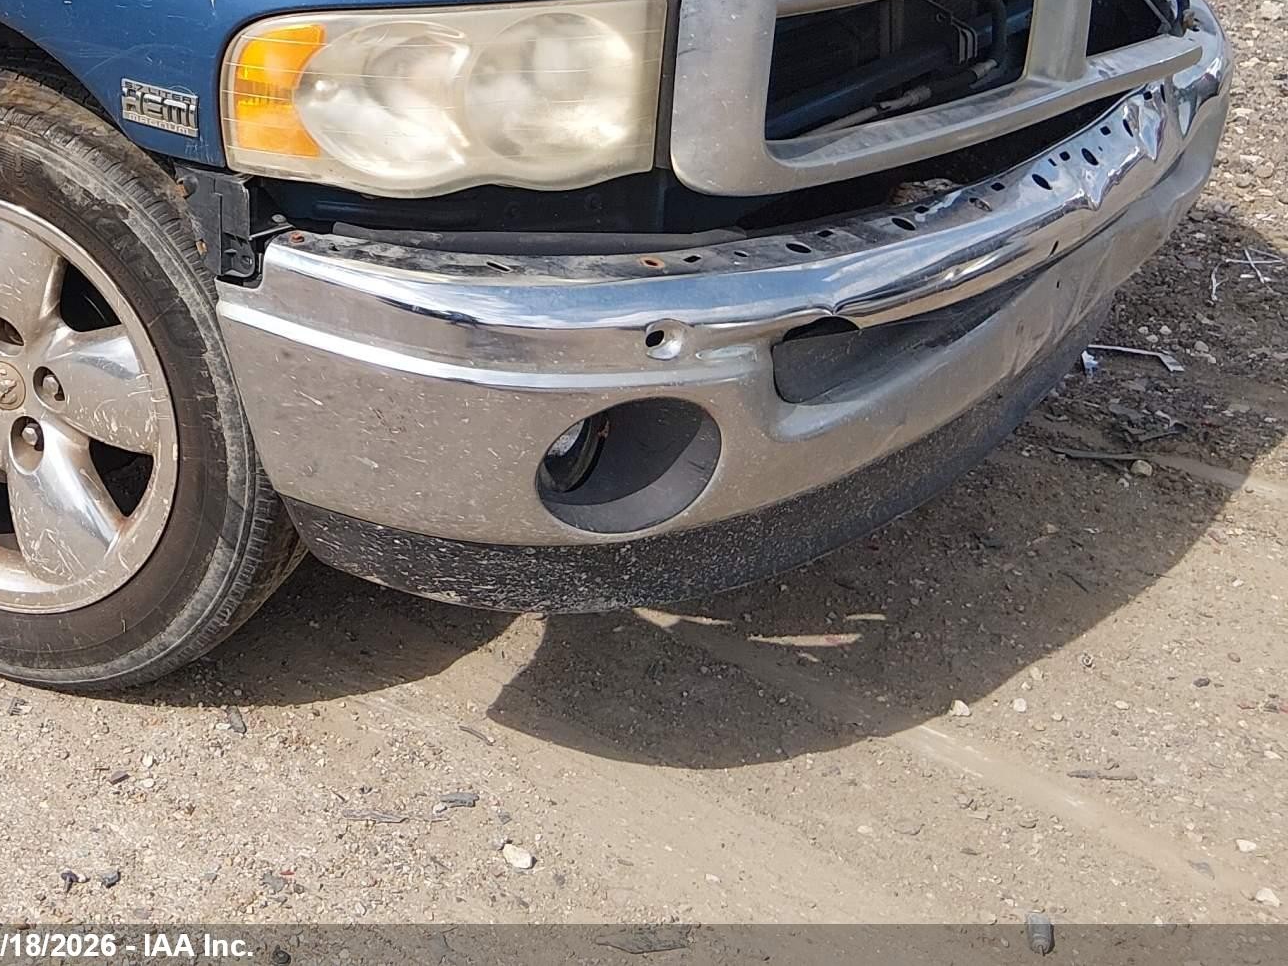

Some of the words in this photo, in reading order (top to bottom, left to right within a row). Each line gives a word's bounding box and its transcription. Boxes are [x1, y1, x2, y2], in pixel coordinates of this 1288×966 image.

[122, 88, 197, 129] HEMI
[124, 81, 143, 92] 5.7
[148, 86, 192, 104] LITER
